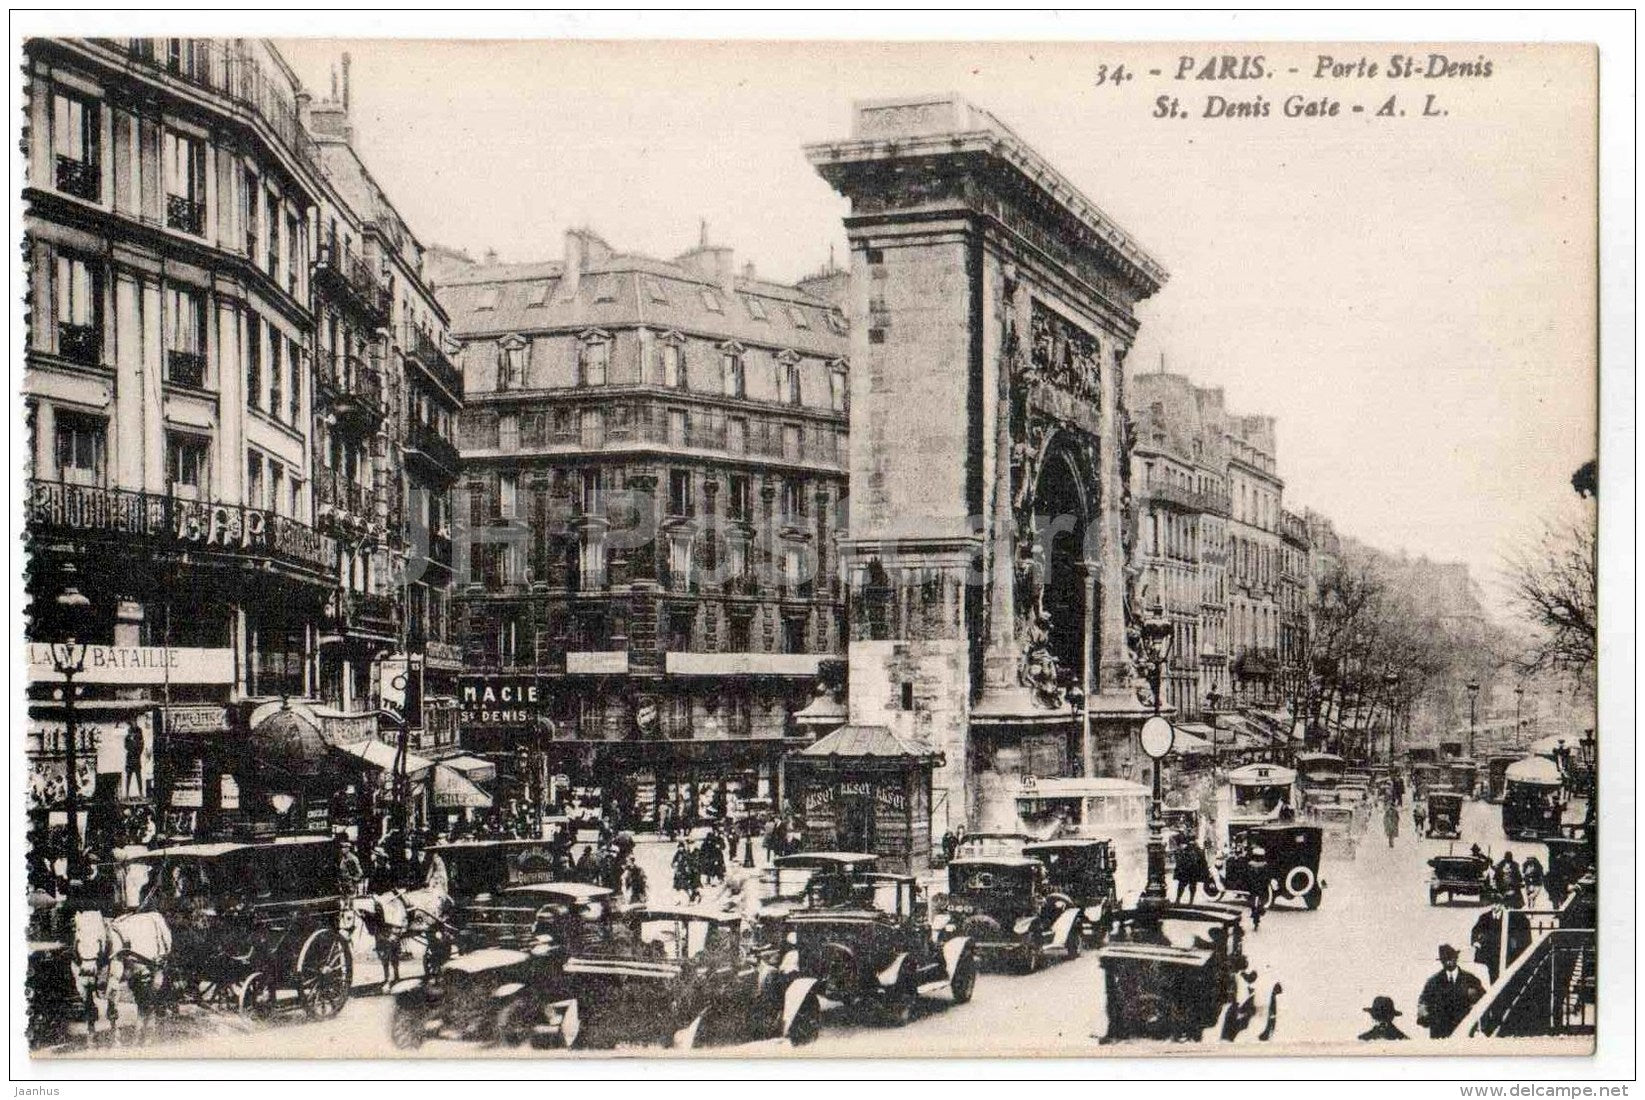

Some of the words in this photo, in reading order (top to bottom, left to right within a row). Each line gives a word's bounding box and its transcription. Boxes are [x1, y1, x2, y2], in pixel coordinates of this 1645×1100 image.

[93, 647, 179, 669] BATAILLE
[463, 686, 538, 702] MACIE
[481, 711, 527, 723] DENIS
